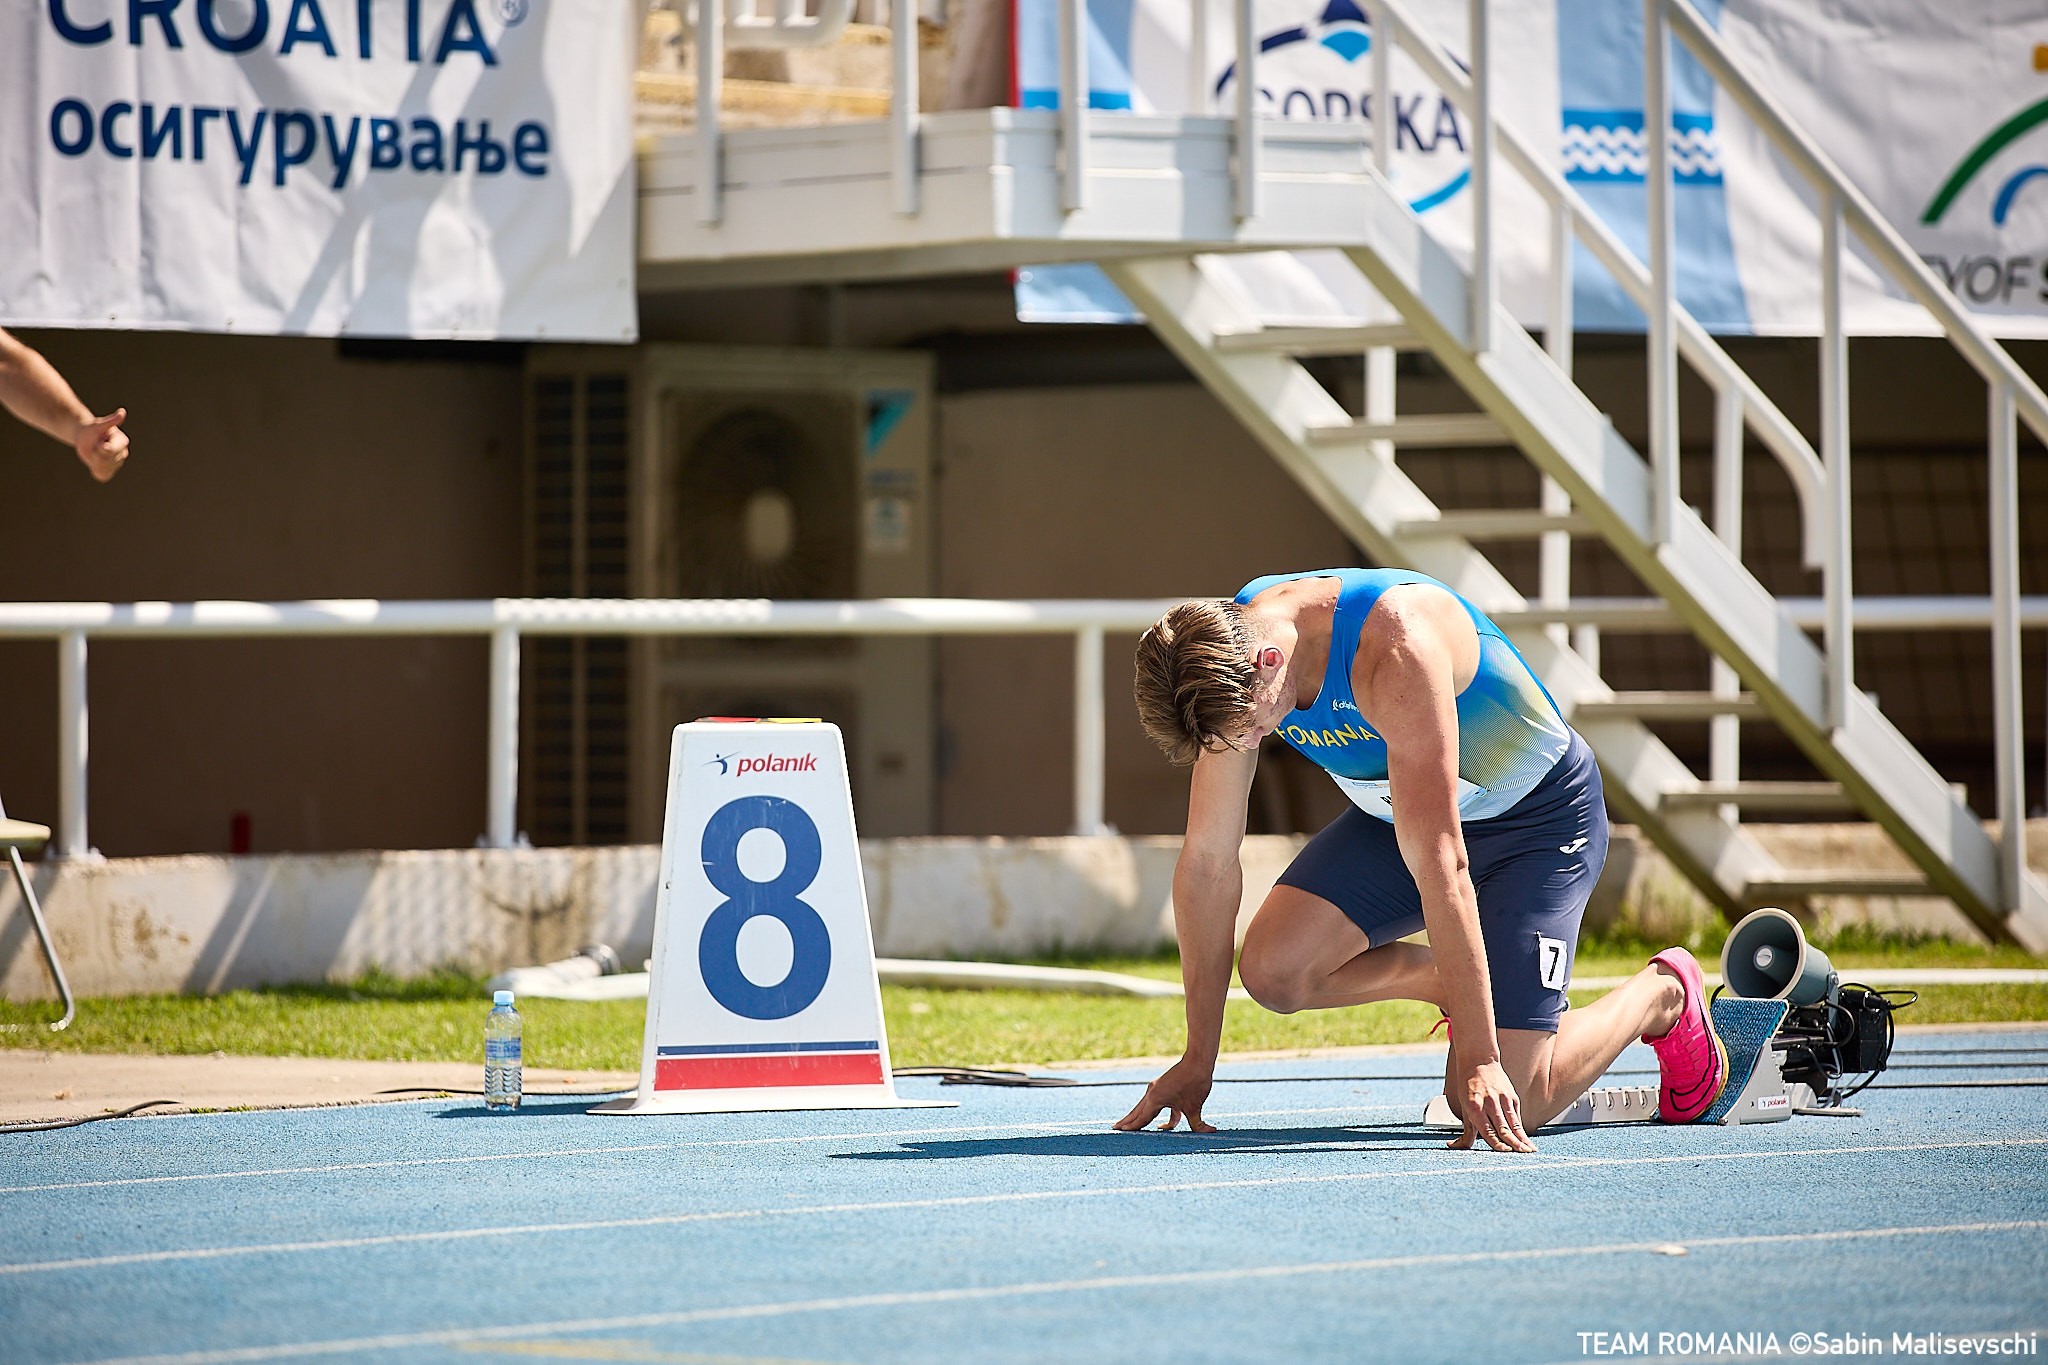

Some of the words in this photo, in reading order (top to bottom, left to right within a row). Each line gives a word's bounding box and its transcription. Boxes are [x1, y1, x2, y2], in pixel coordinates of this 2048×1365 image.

[50, 97, 550, 190] осигурување
[736, 753, 818, 777] polanik
[699, 796, 831, 1020] 8
[1548, 946, 1559, 982] 7
